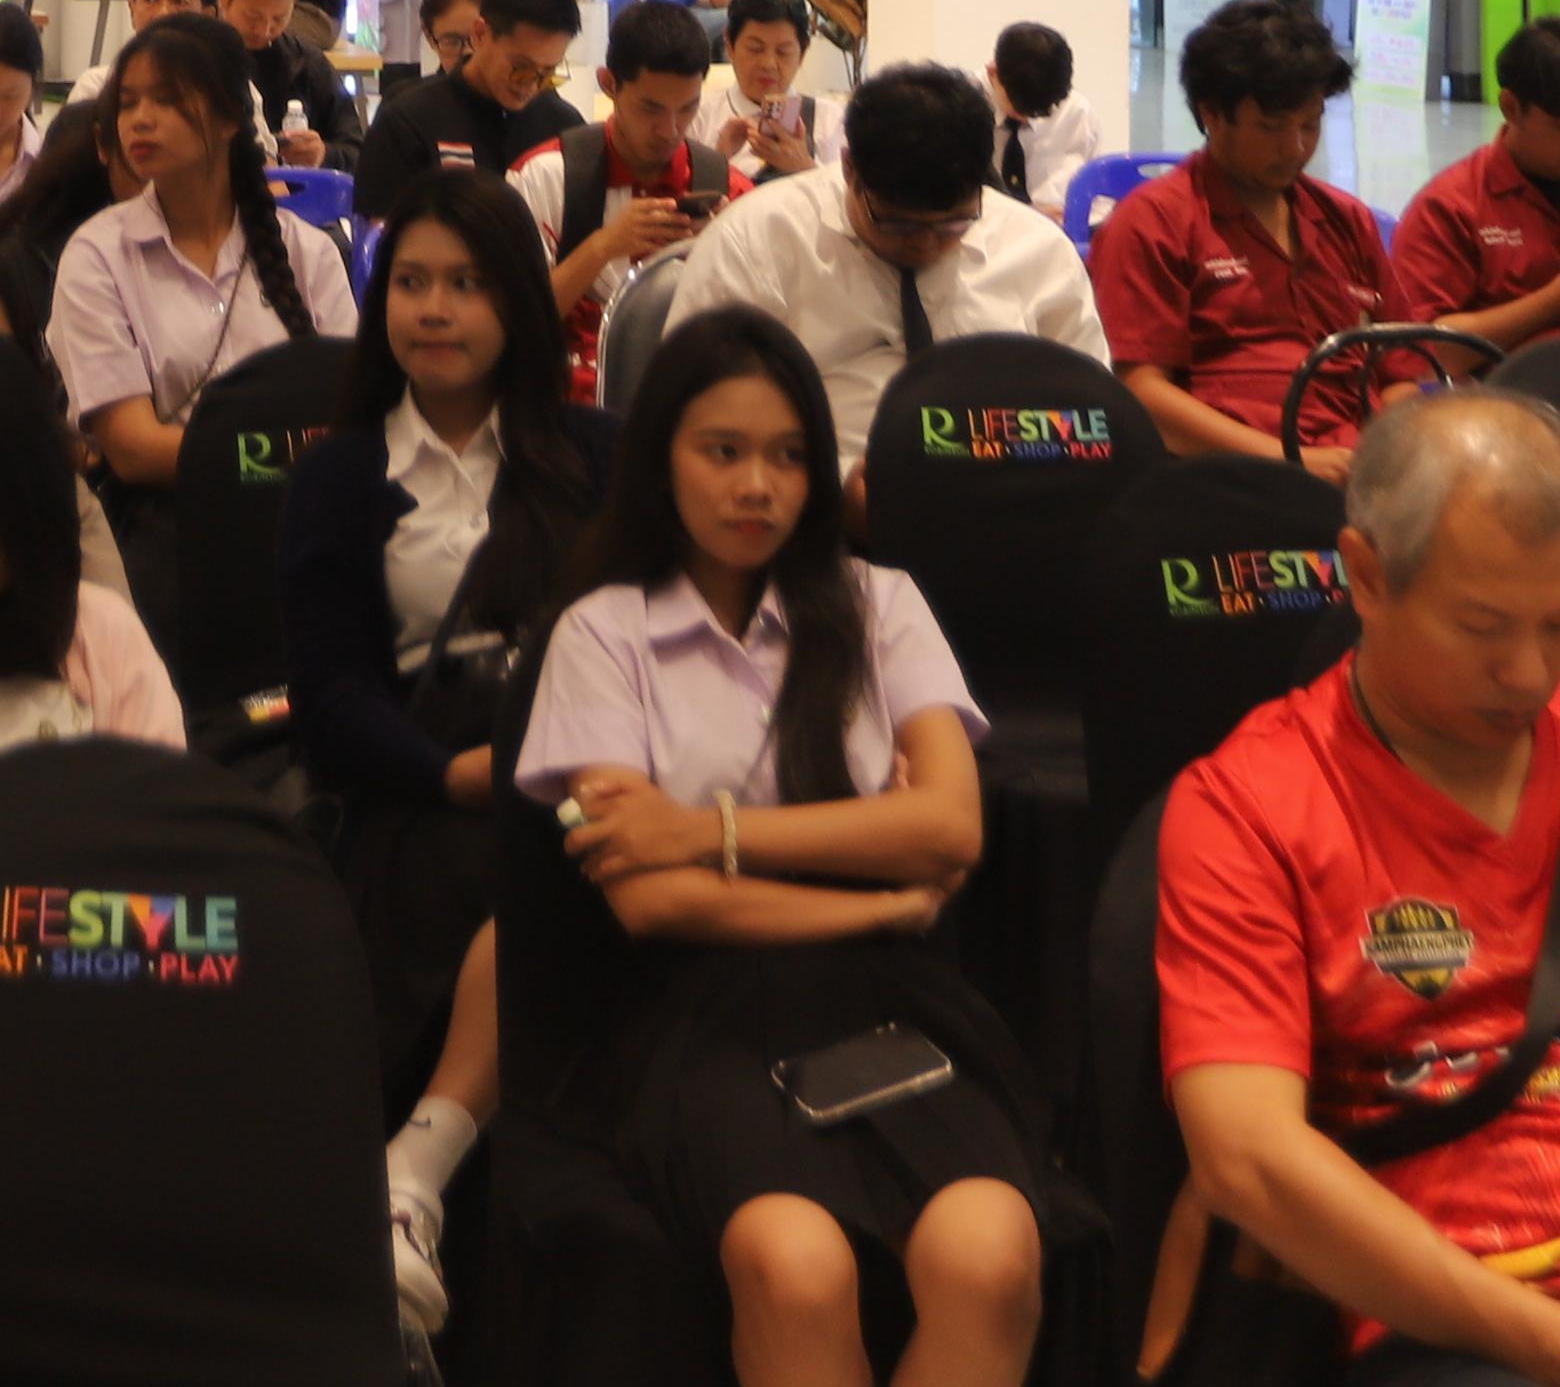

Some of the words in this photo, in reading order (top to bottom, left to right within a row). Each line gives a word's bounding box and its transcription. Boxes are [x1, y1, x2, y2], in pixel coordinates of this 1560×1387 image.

[967, 408, 1111, 443] LIFESTYLE
[1070, 441, 1113, 460] PLAY
[1211, 549, 1349, 594] LIFESTYL
[51, 948, 141, 978] SHOP
[158, 953, 239, 984] PLAY
